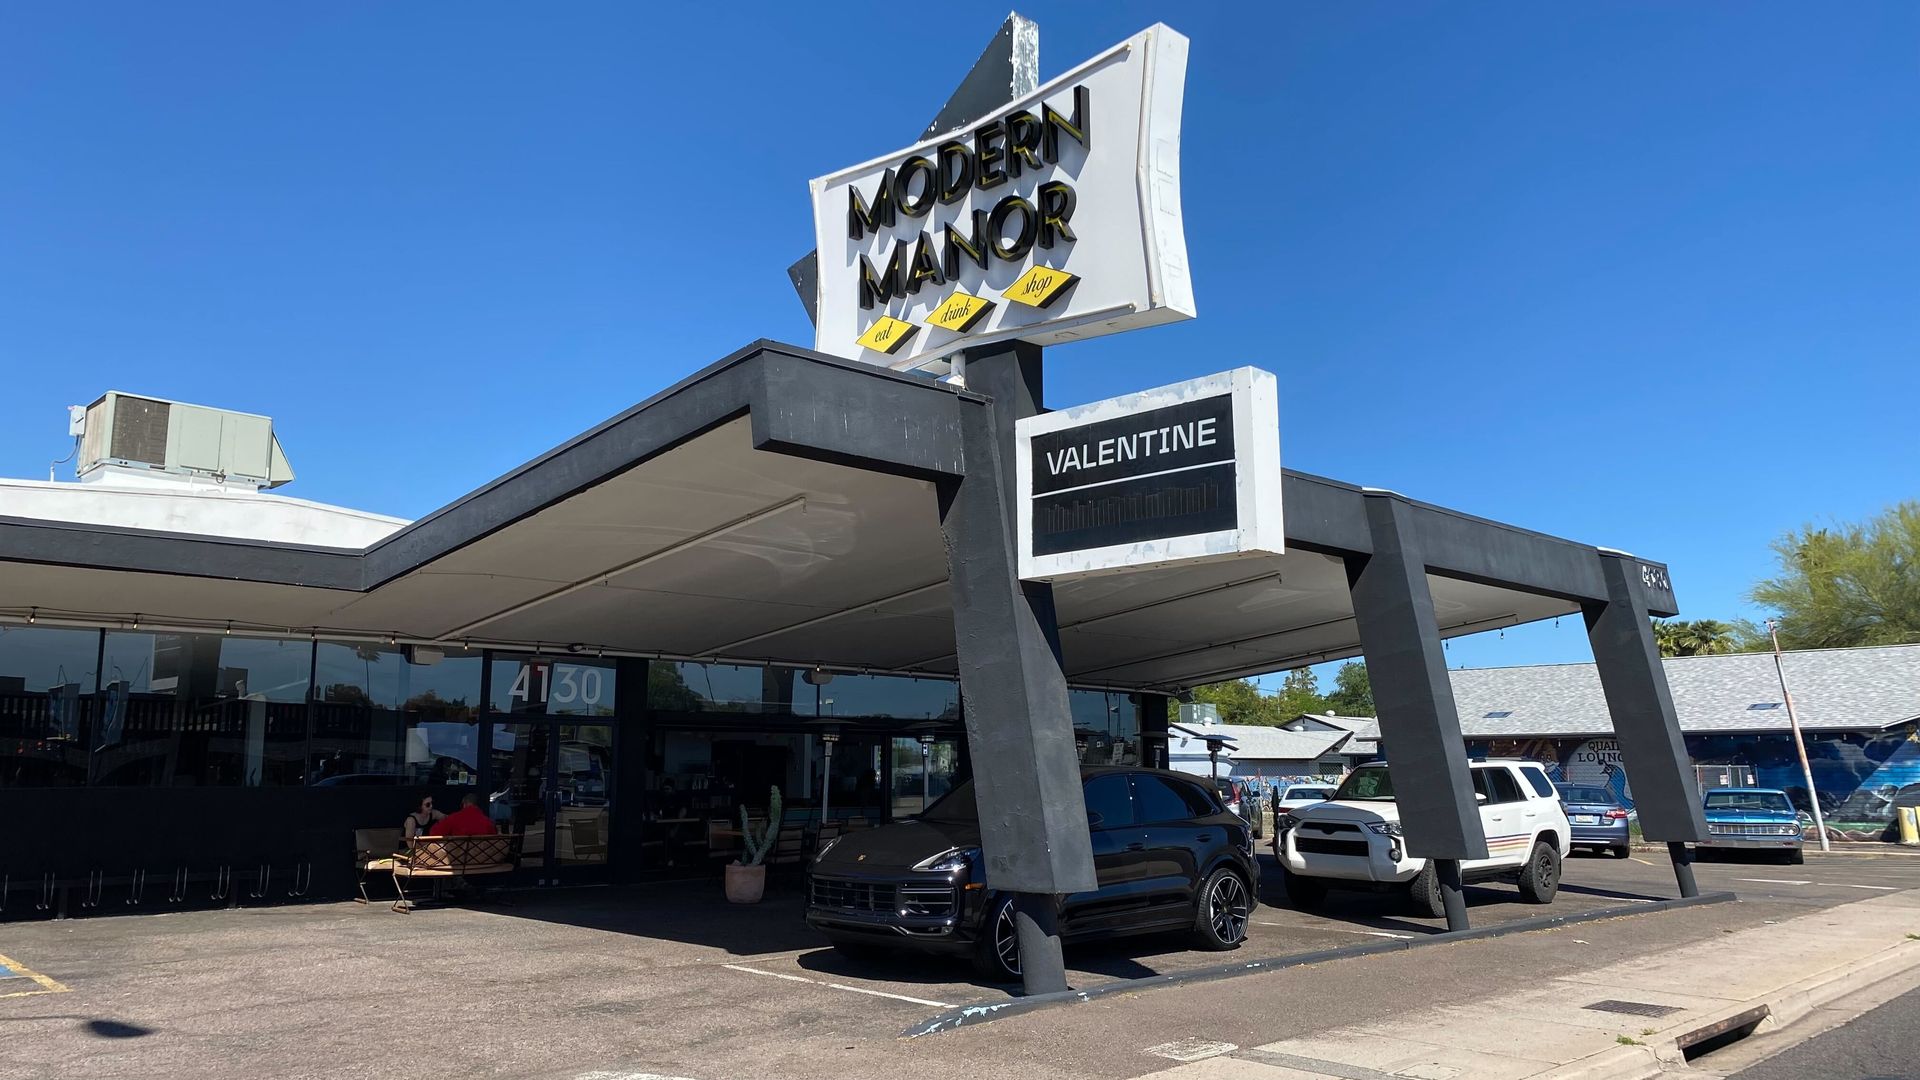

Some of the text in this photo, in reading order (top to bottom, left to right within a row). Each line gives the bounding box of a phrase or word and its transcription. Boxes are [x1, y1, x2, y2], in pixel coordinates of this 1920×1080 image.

[849, 85, 1090, 240] MODERN
[859, 180, 1077, 310] MANOR
[874, 273, 1052, 342] eat drink shop
[1046, 417, 1216, 475] VALENTINE
[507, 664, 602, 704] 4130
